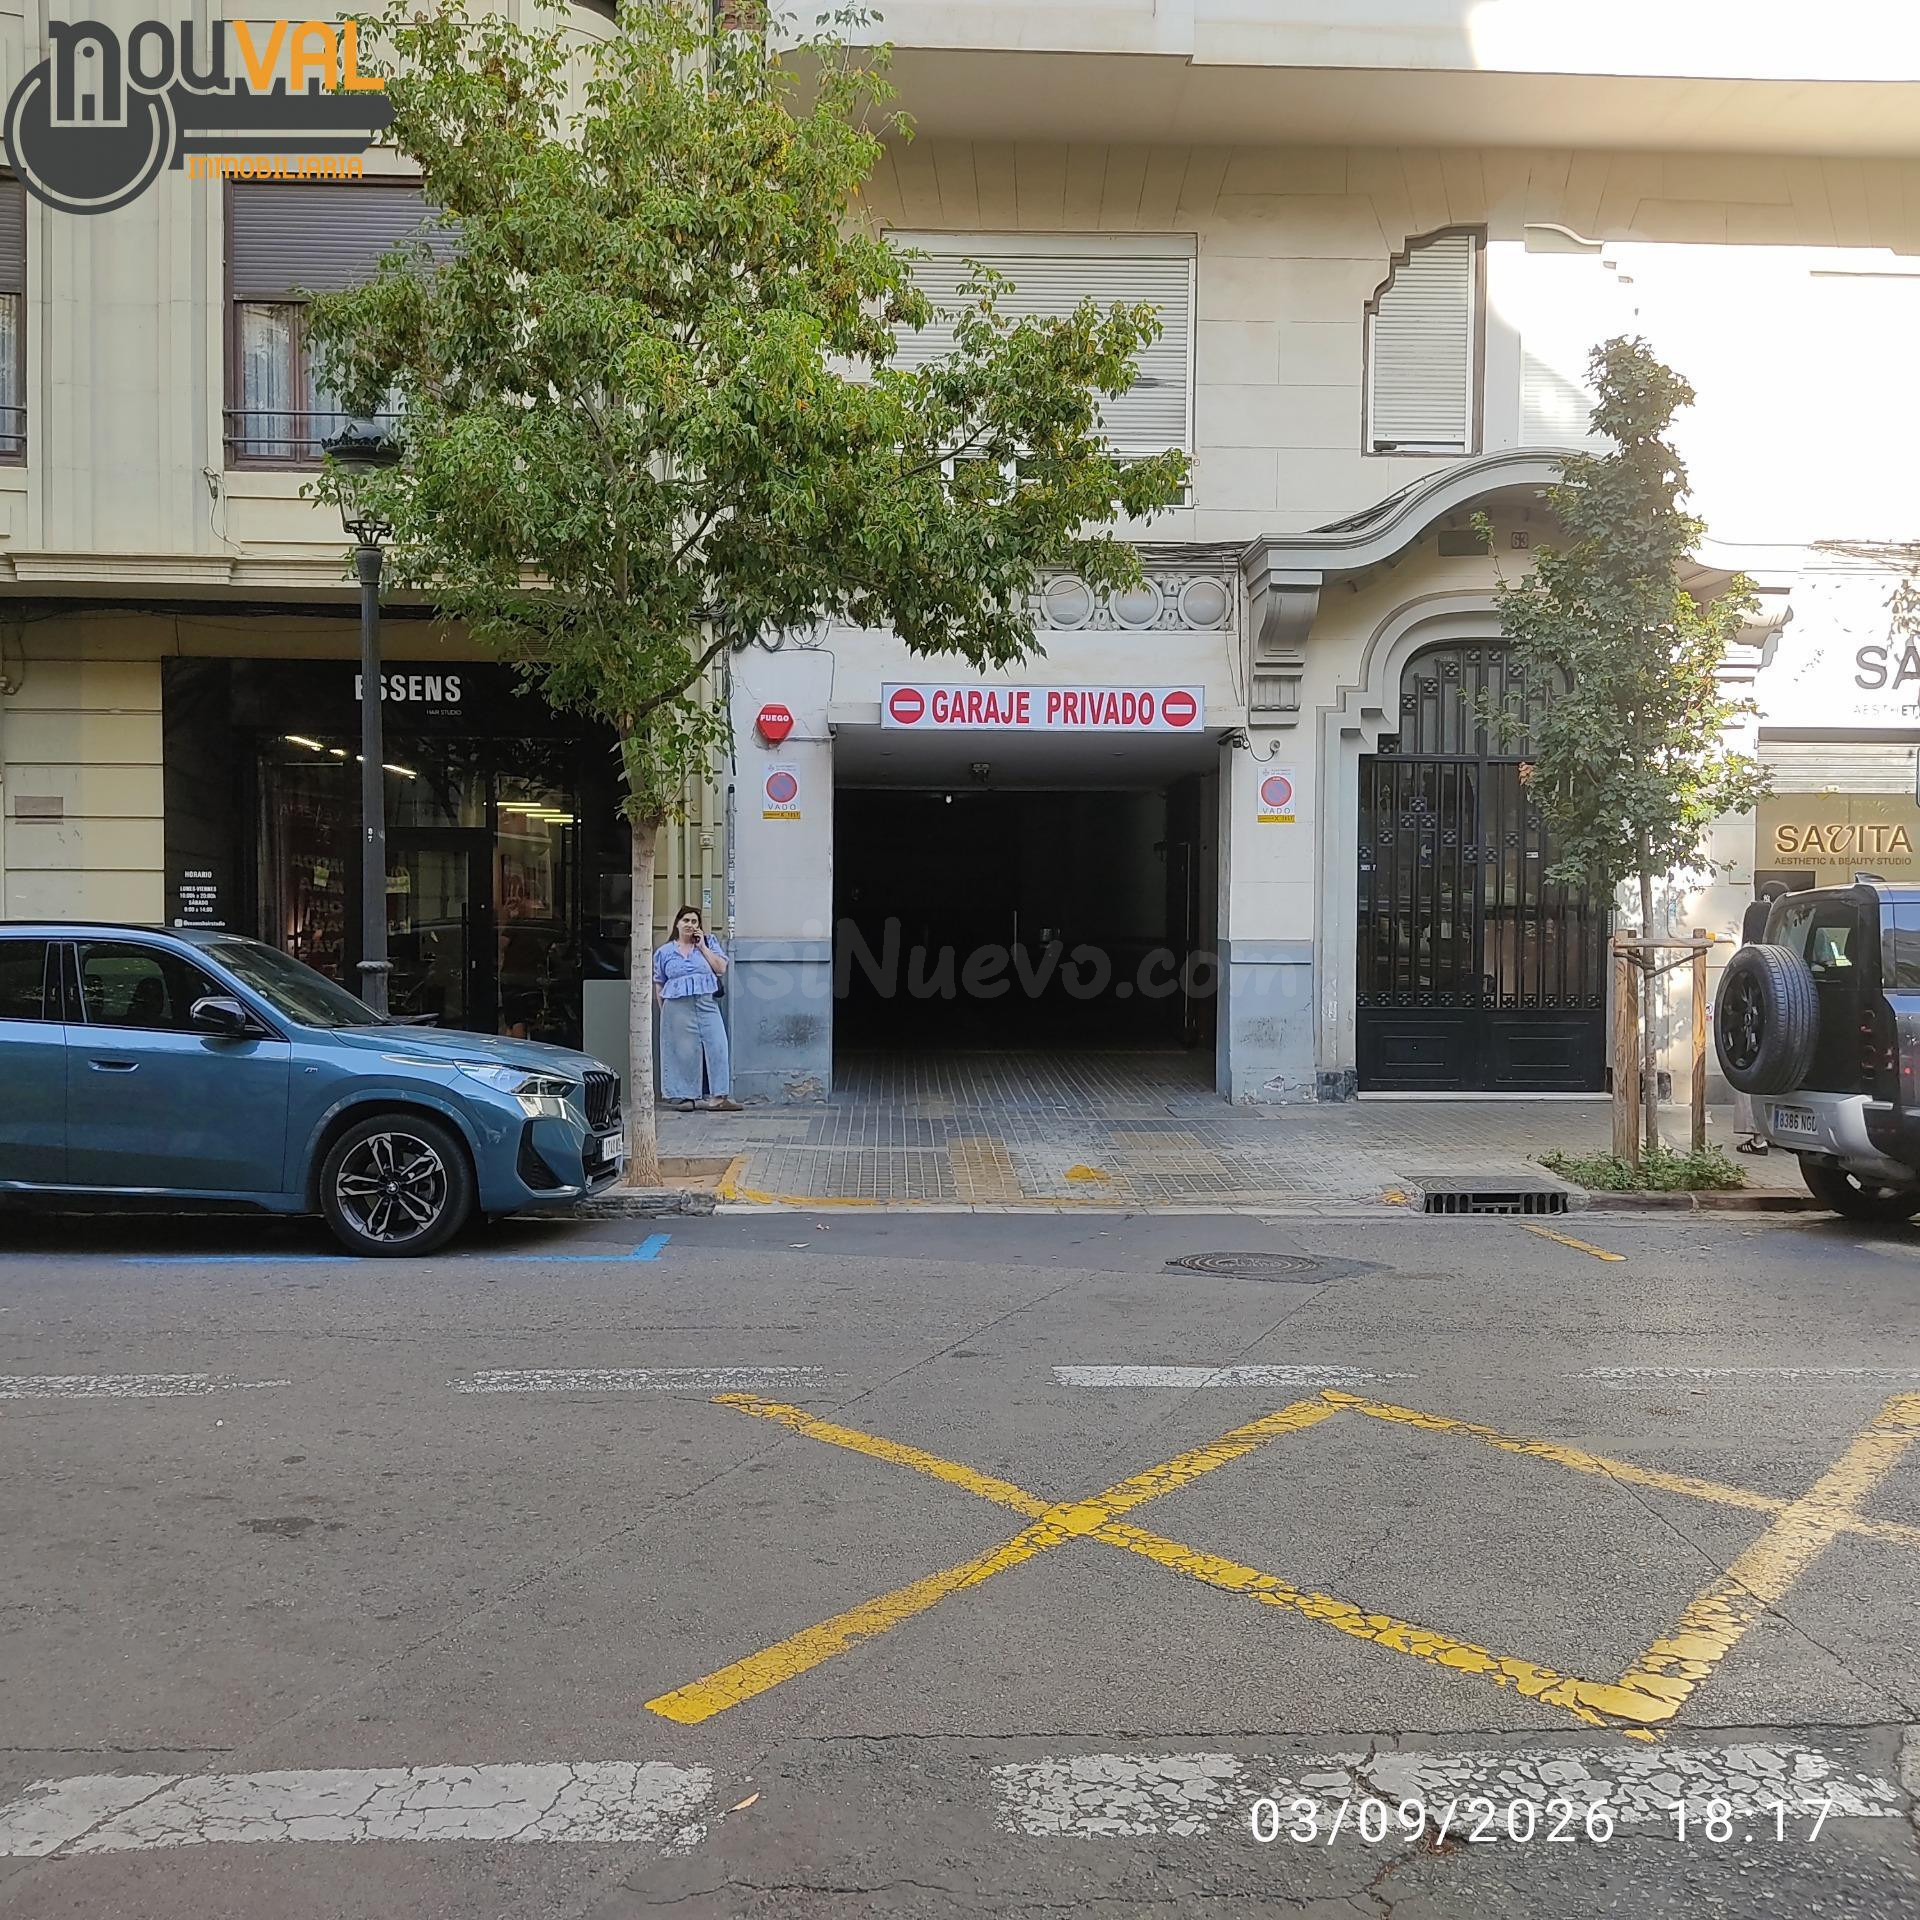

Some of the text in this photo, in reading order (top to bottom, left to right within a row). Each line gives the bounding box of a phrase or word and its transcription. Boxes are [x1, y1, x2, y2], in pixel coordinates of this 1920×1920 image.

[931, 689, 1155, 726] GARAJE PRIVADO
[760, 714, 790, 722] FUEGO
[767, 803, 797, 811] VADO
[1262, 807, 1291, 815] VADO
[1776, 825, 1913, 853] SAVITA
[1774, 857, 1912, 866] AESTHETIC & BEAUTY STUDIO
[184, 870, 213, 879] HORARIO
[1779, 1112, 1799, 1130] 8386
